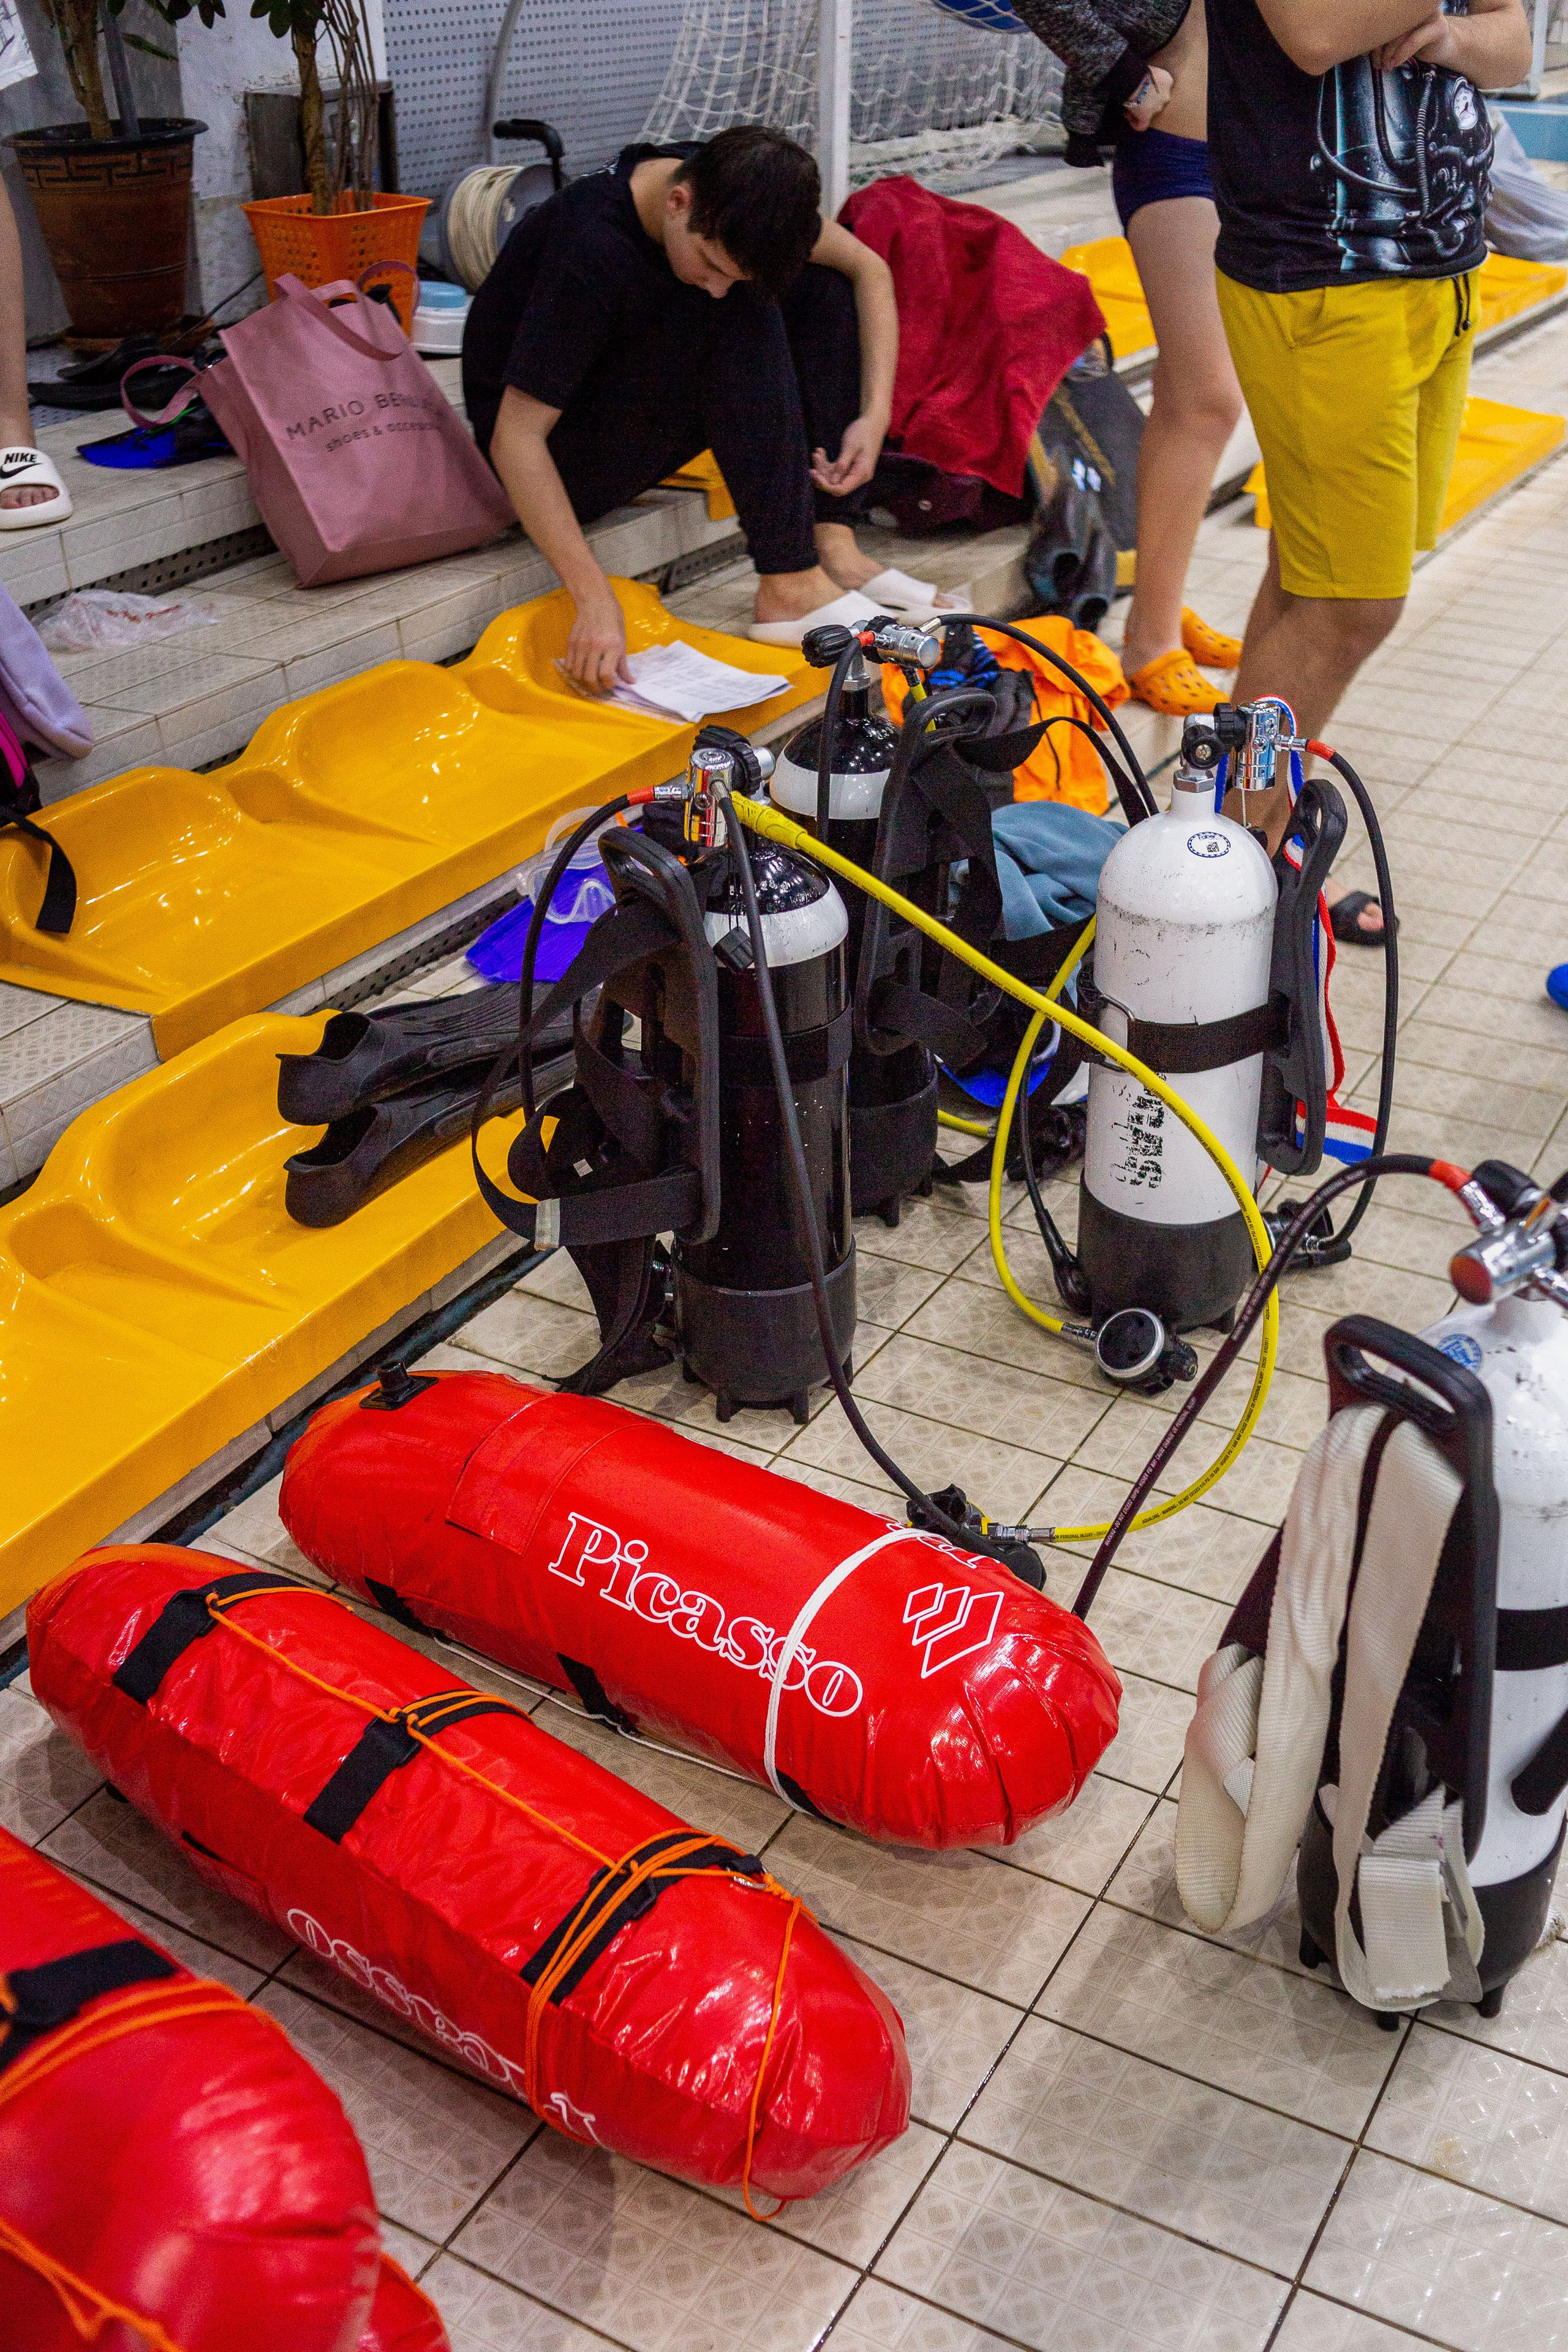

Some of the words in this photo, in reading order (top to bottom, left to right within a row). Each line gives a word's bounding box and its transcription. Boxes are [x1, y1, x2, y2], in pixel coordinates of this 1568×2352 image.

[285, 399, 365, 440] MARIO
[326, 428, 371, 453] shoes
[4, 453, 38, 464] NIKE
[1215, 1159, 1227, 1174] CAUSE
[1140, 1512, 1160, 1524] AQUALUNG
[1238, 1421, 1248, 1434] CAUSE
[1244, 1407, 1254, 1423] DAMAGE
[1113, 1519, 1121, 1528] DO
[548, 1512, 863, 1717] Picasso
